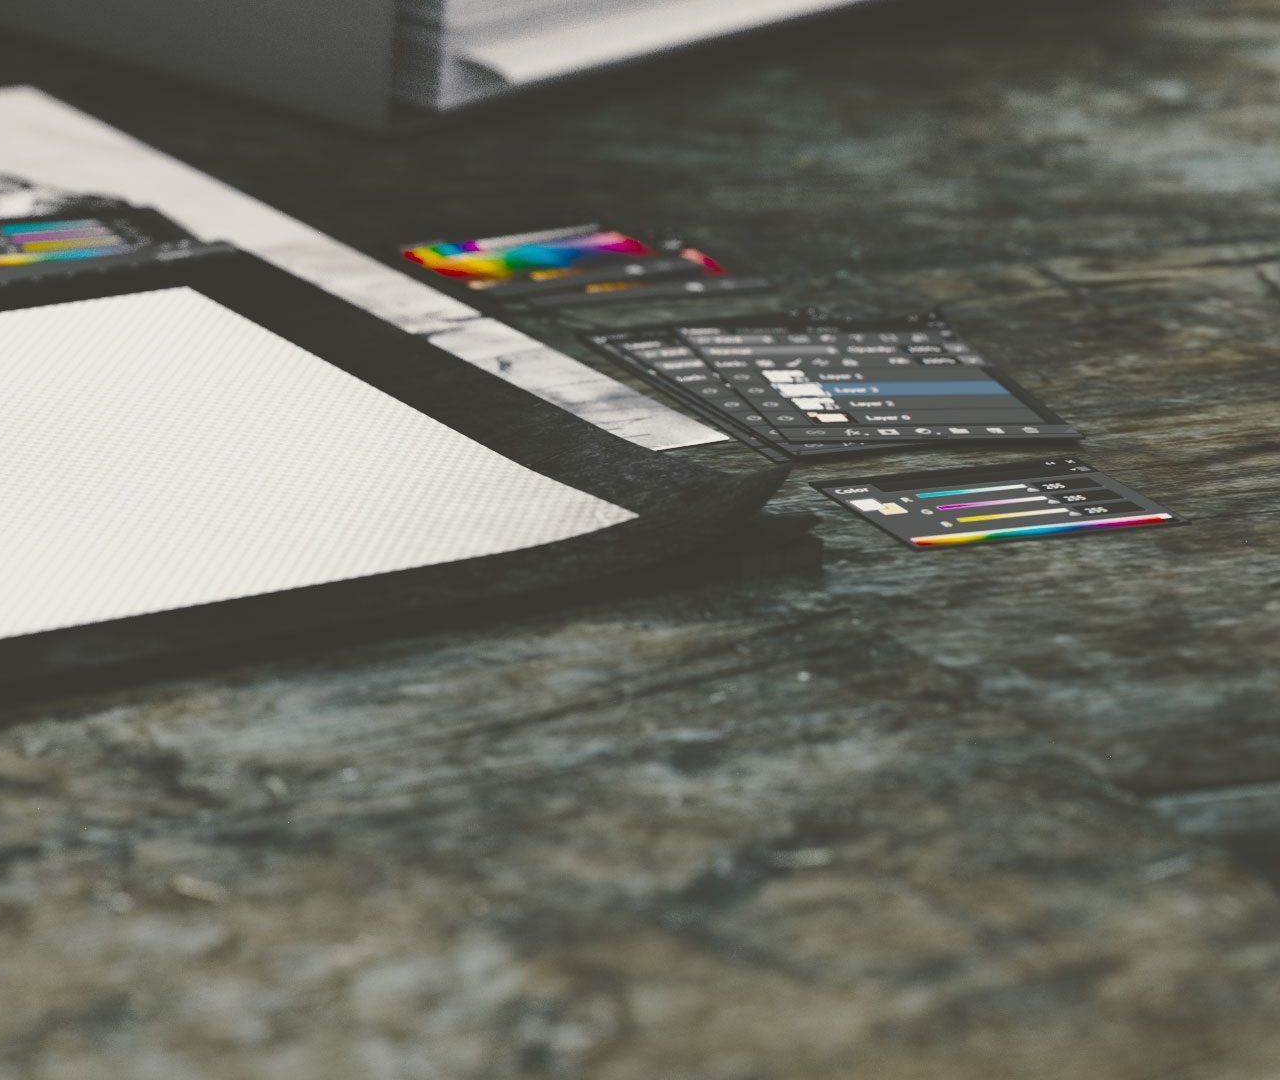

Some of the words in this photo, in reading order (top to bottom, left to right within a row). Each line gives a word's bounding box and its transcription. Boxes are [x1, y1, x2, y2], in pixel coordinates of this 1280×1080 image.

[865, 414, 899, 422] Layer
[1041, 481, 1066, 490] 255
[834, 485, 870, 495] Color
[1063, 494, 1087, 502] 255
[1084, 506, 1108, 514] 255
